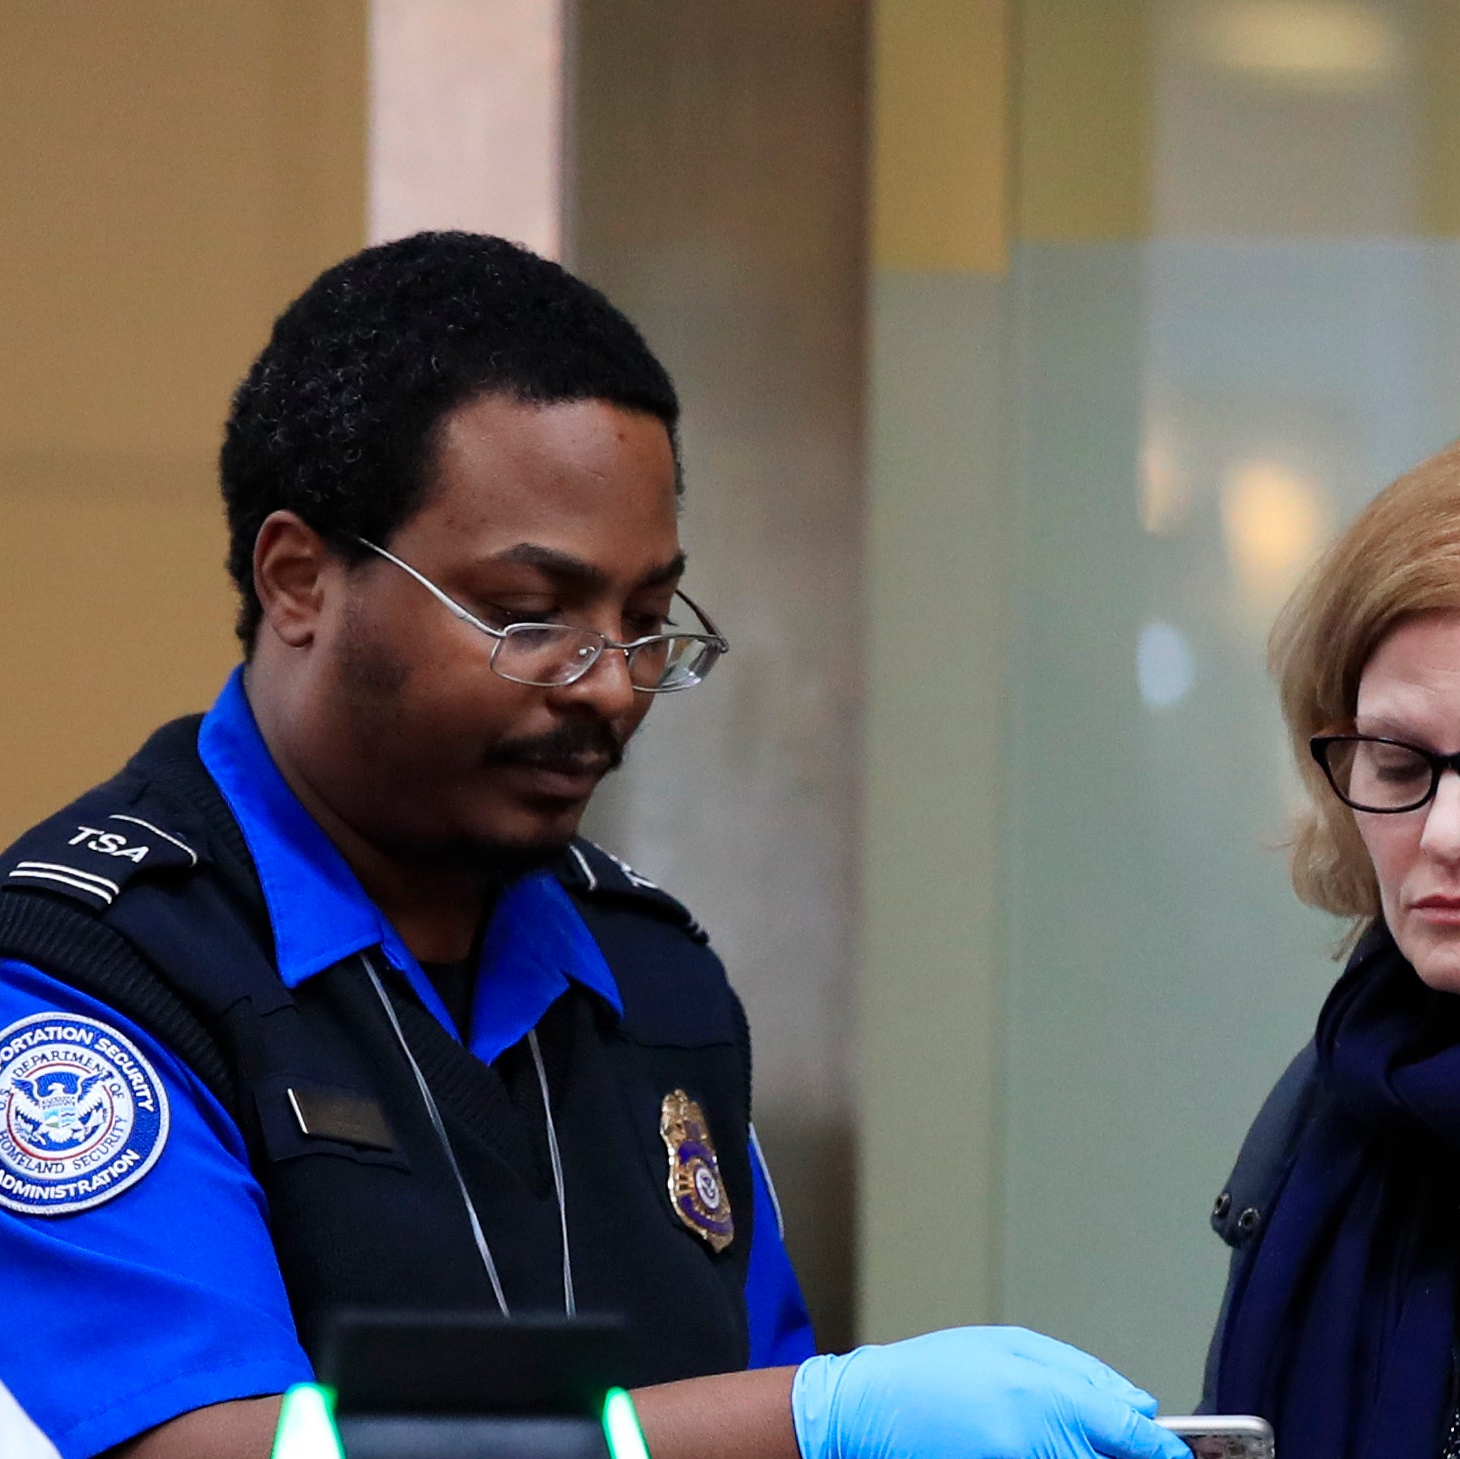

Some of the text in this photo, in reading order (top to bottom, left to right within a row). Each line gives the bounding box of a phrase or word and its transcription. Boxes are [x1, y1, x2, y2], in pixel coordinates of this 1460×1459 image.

[67, 826, 151, 863] TSA
[13, 1050, 114, 1081] DEPARTMENT
[109, 1083, 124, 1099] OF
[94, 1037, 154, 1112] SECURITY
[73, 1115, 127, 1170] SECURITY
